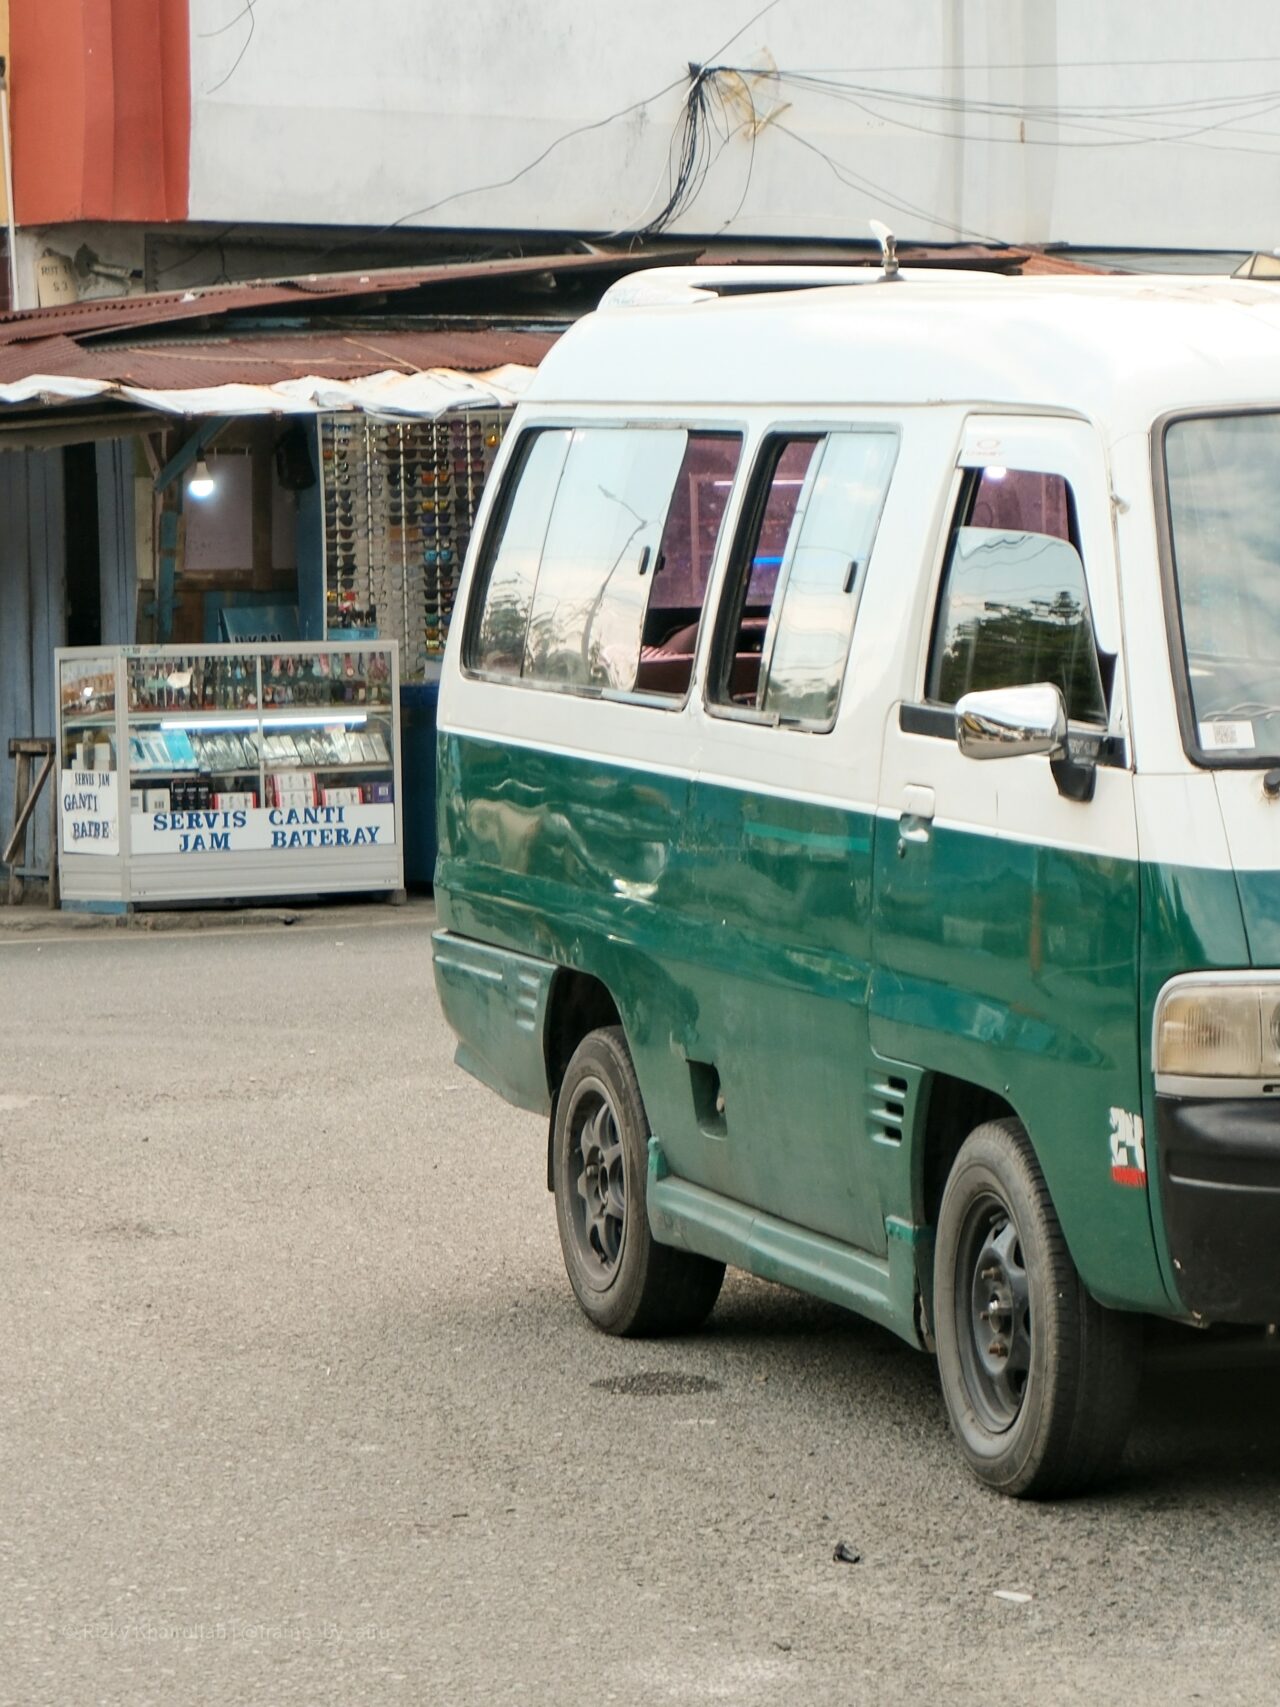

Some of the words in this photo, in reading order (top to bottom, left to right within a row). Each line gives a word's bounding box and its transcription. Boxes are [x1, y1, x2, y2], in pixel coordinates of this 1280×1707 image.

[74, 772, 94, 786] SERVIS
[98, 773, 110, 788] JAM
[63, 792, 98, 812] GANTI
[153, 810, 247, 831] SERVIS
[178, 832, 231, 852] JAM
[270, 826, 381, 849] BATERAY
